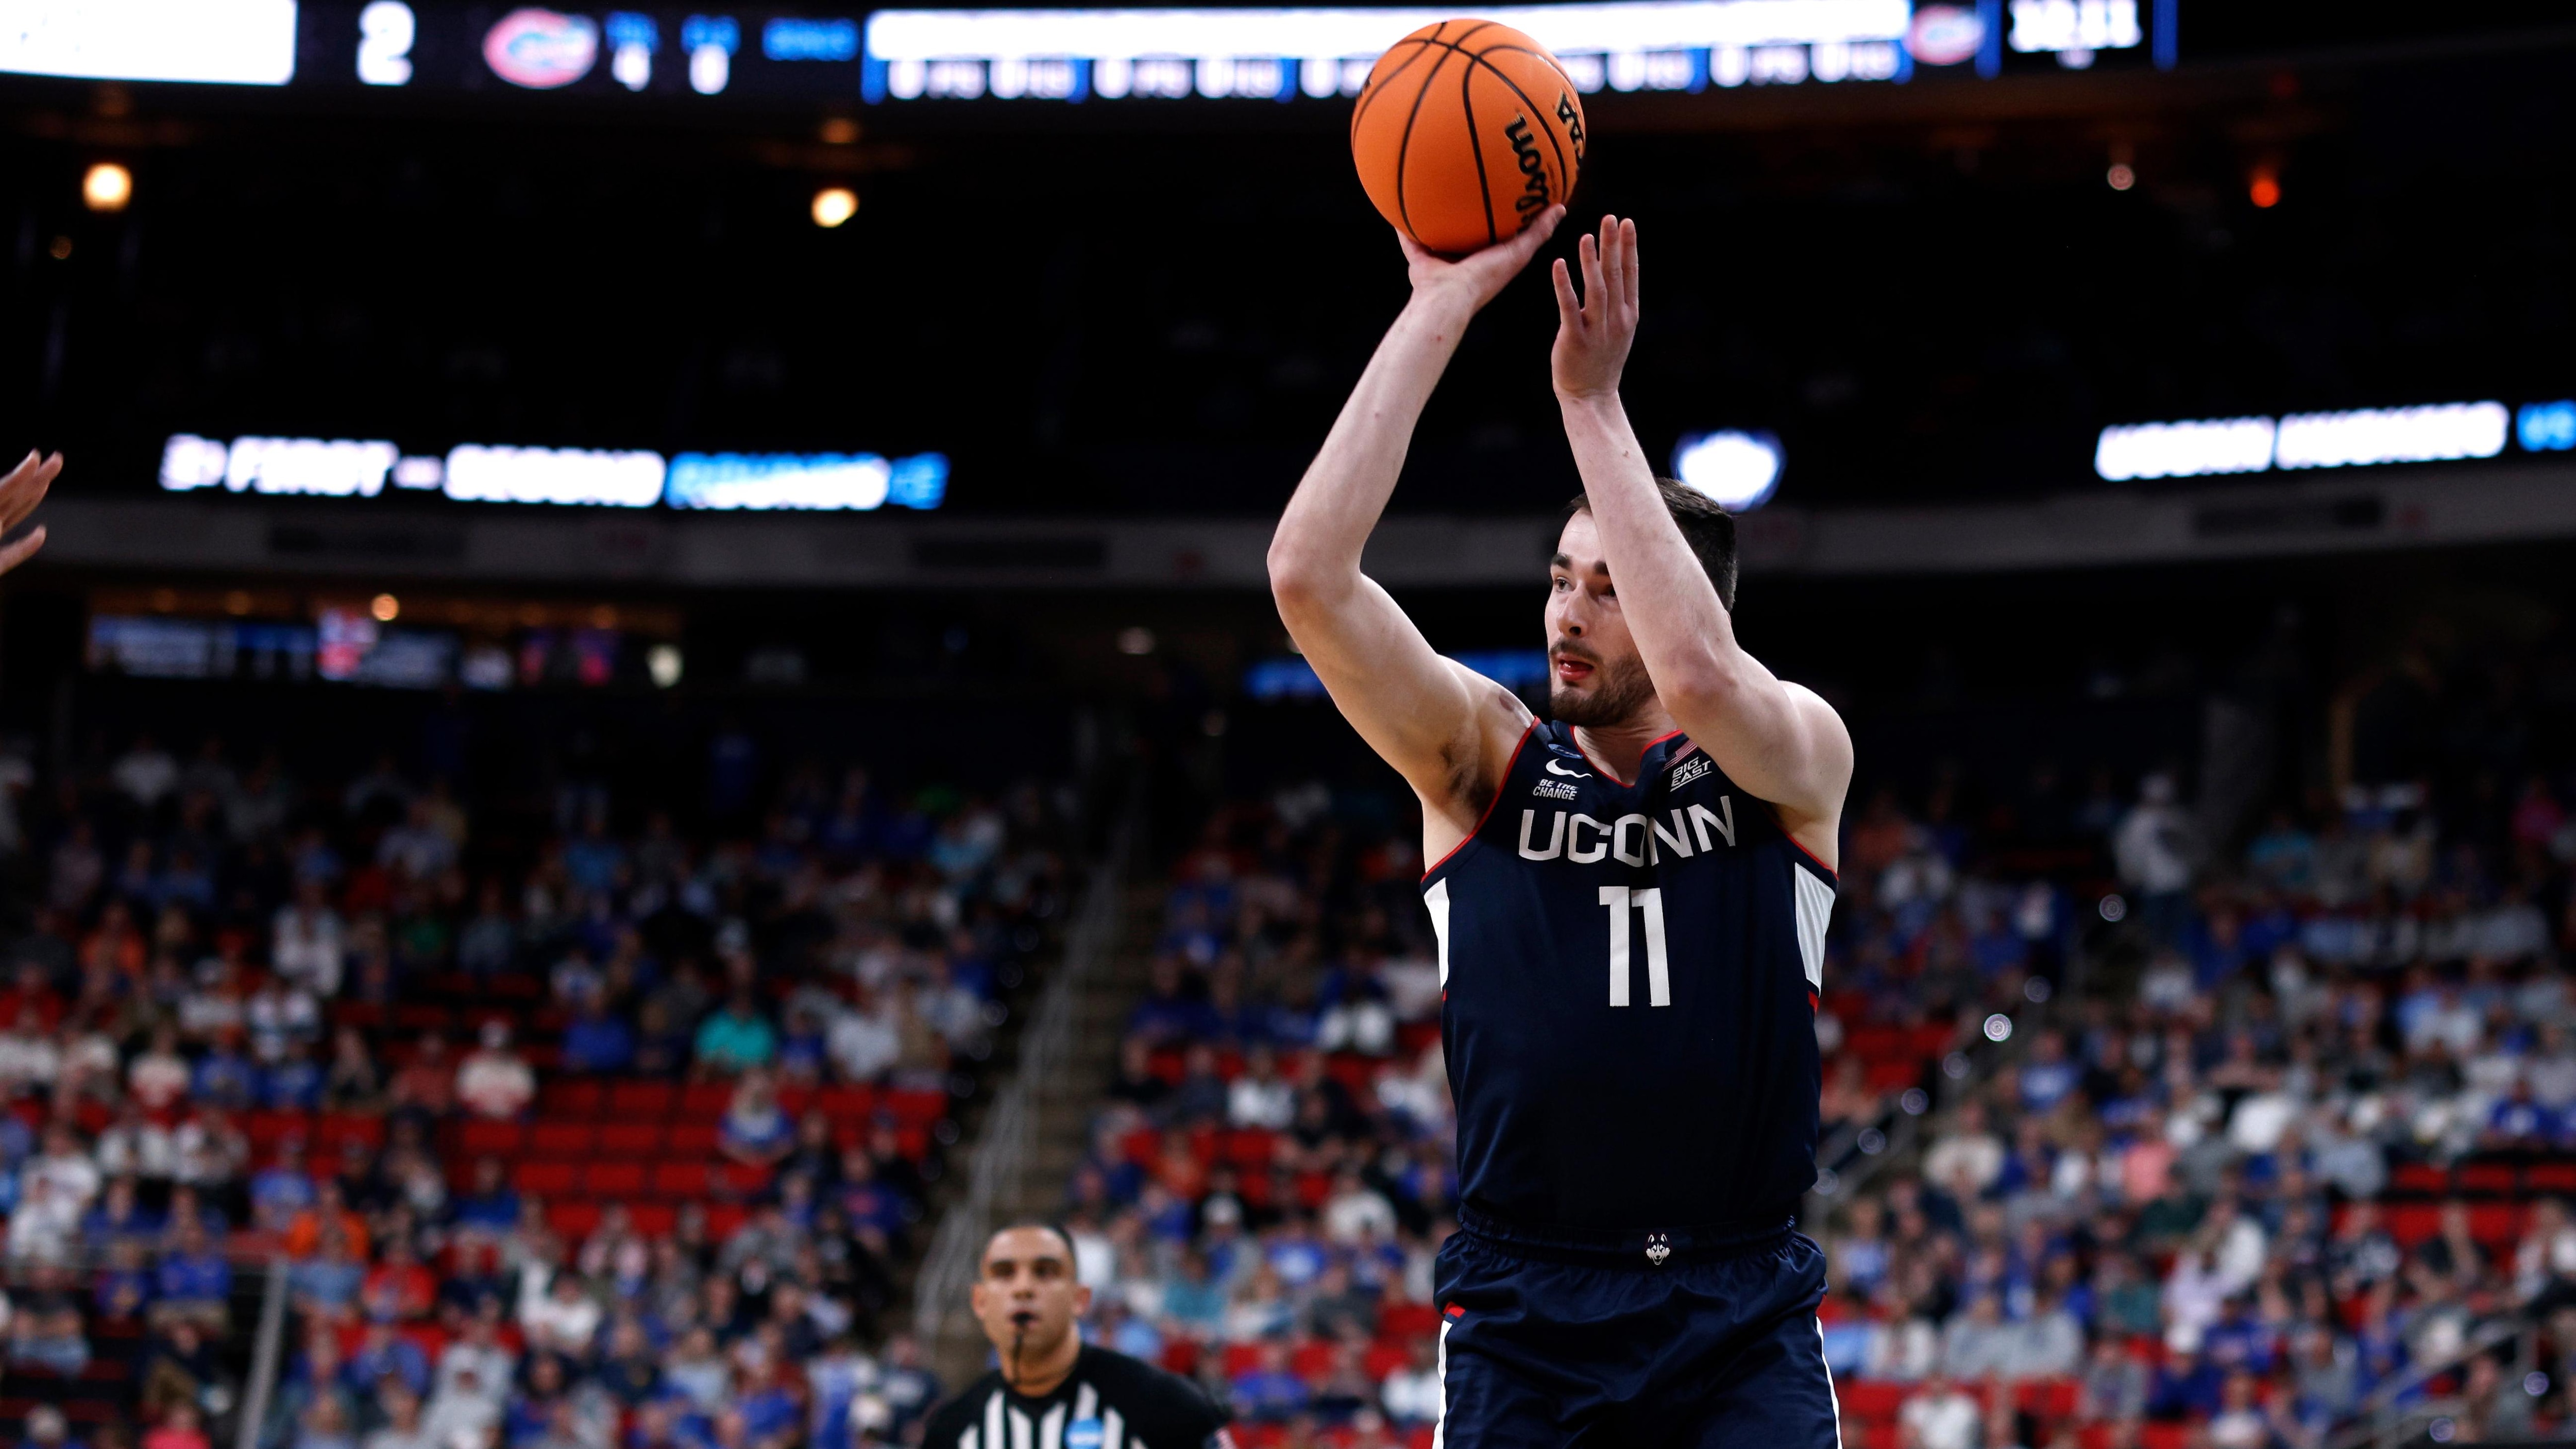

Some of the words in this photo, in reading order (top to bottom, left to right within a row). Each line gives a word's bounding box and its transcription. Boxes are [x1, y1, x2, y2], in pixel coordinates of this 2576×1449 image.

[357, 1, 415, 85] 2
[1671, 760, 1711, 787] EAST
[1672, 756, 1699, 778] BIG
[1533, 786, 1577, 800] CHANGE
[1539, 779, 1555, 787] BE
[1557, 782, 1578, 791] THE
[1518, 796, 1736, 867] UCONN
[1599, 886, 1671, 1007] 11
